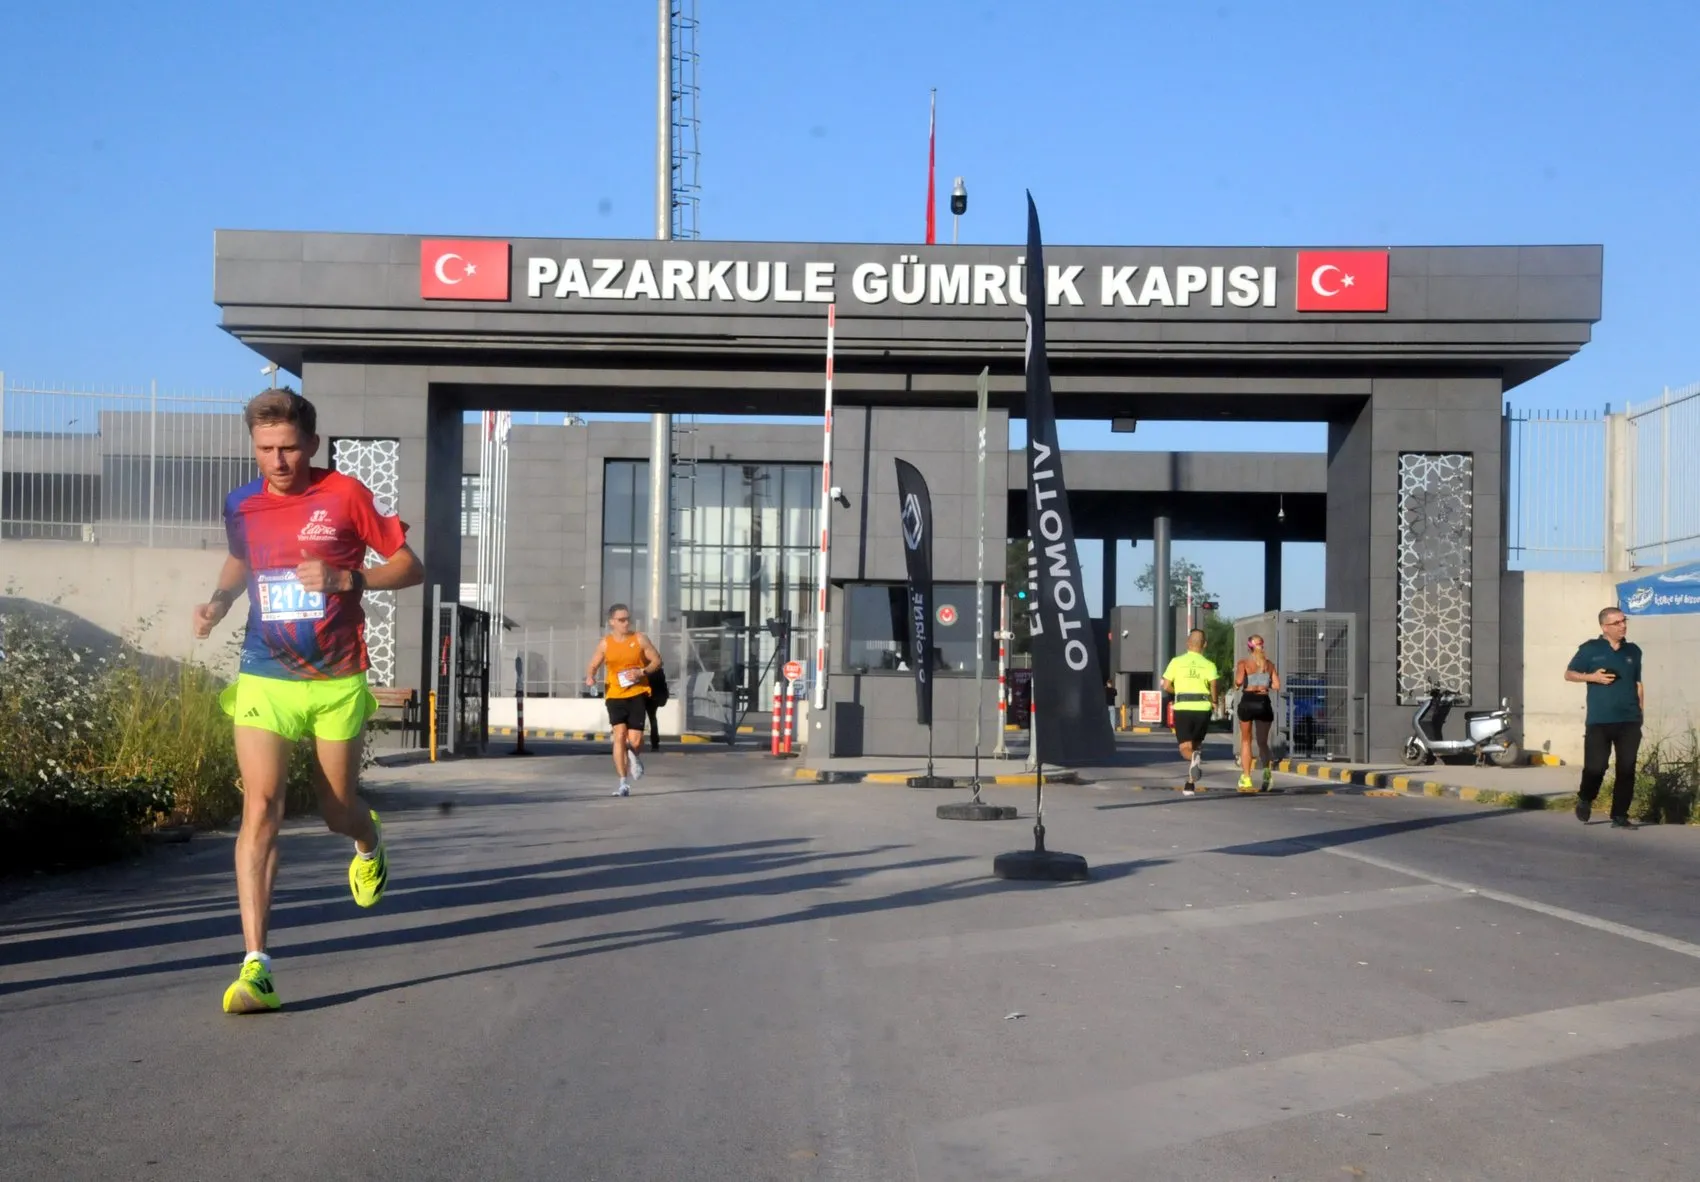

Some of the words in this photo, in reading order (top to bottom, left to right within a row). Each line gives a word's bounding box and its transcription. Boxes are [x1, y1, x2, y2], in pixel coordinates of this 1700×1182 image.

[528, 258, 836, 303] PAZARKULE
[1101, 265, 1277, 307] KAPISI
[1032, 438, 1089, 671] OTOMOTIV
